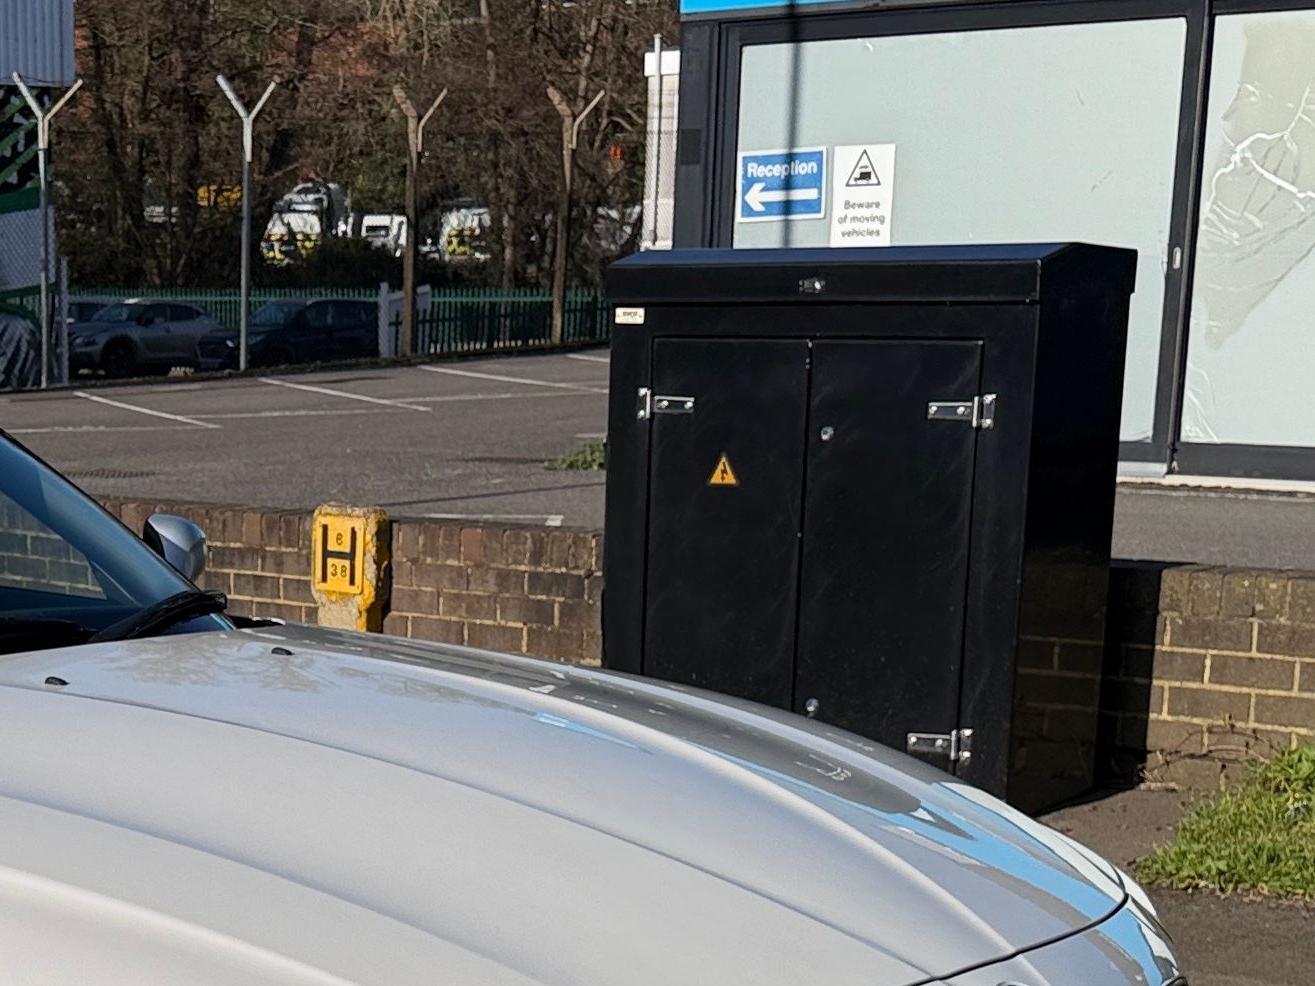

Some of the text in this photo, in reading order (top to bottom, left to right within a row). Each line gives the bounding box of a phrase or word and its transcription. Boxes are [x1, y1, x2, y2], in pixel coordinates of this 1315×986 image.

[747, 160, 818, 179] Reception
[844, 200, 881, 210] Beware
[838, 213, 885, 225] of moving
[841, 227, 881, 238] vehicles
[322, 524, 357, 586] H
[330, 563, 348, 579] 38
